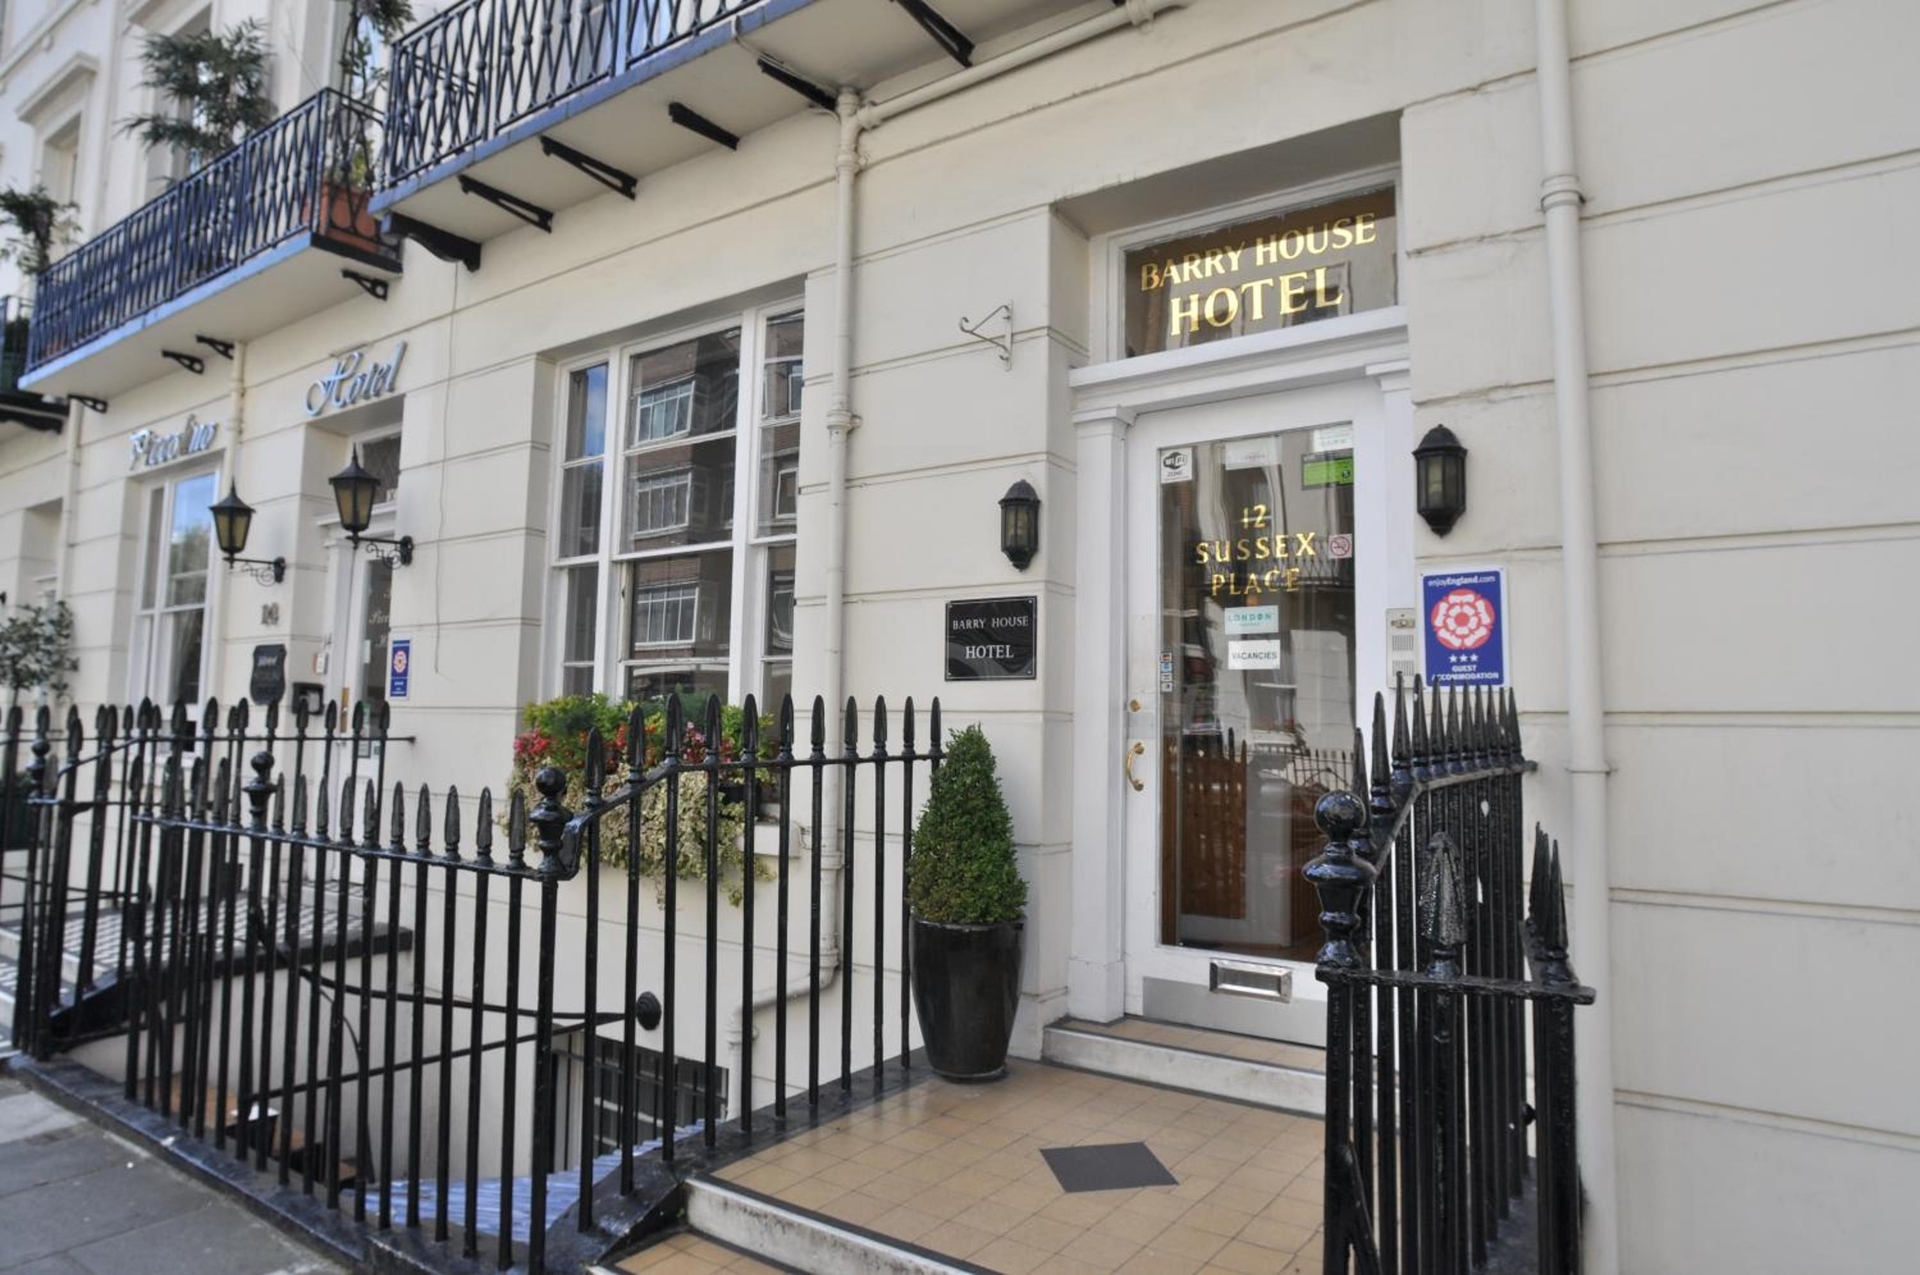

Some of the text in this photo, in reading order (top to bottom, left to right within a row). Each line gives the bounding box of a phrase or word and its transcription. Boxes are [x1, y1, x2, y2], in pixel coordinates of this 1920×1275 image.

[1141, 212, 1378, 292] BARRY HOUSE
[1170, 266, 1344, 337] HOTEL
[306, 339, 407, 416] Hotel
[1243, 504, 1267, 529] 12
[1196, 532, 1316, 564] SUSSEX
[1211, 566, 1300, 596] PLACE
[952, 615, 1029, 630] BARRY HOUSE
[965, 644, 1015, 659] HOTEL
[1232, 652, 1277, 660] VACANCIES
